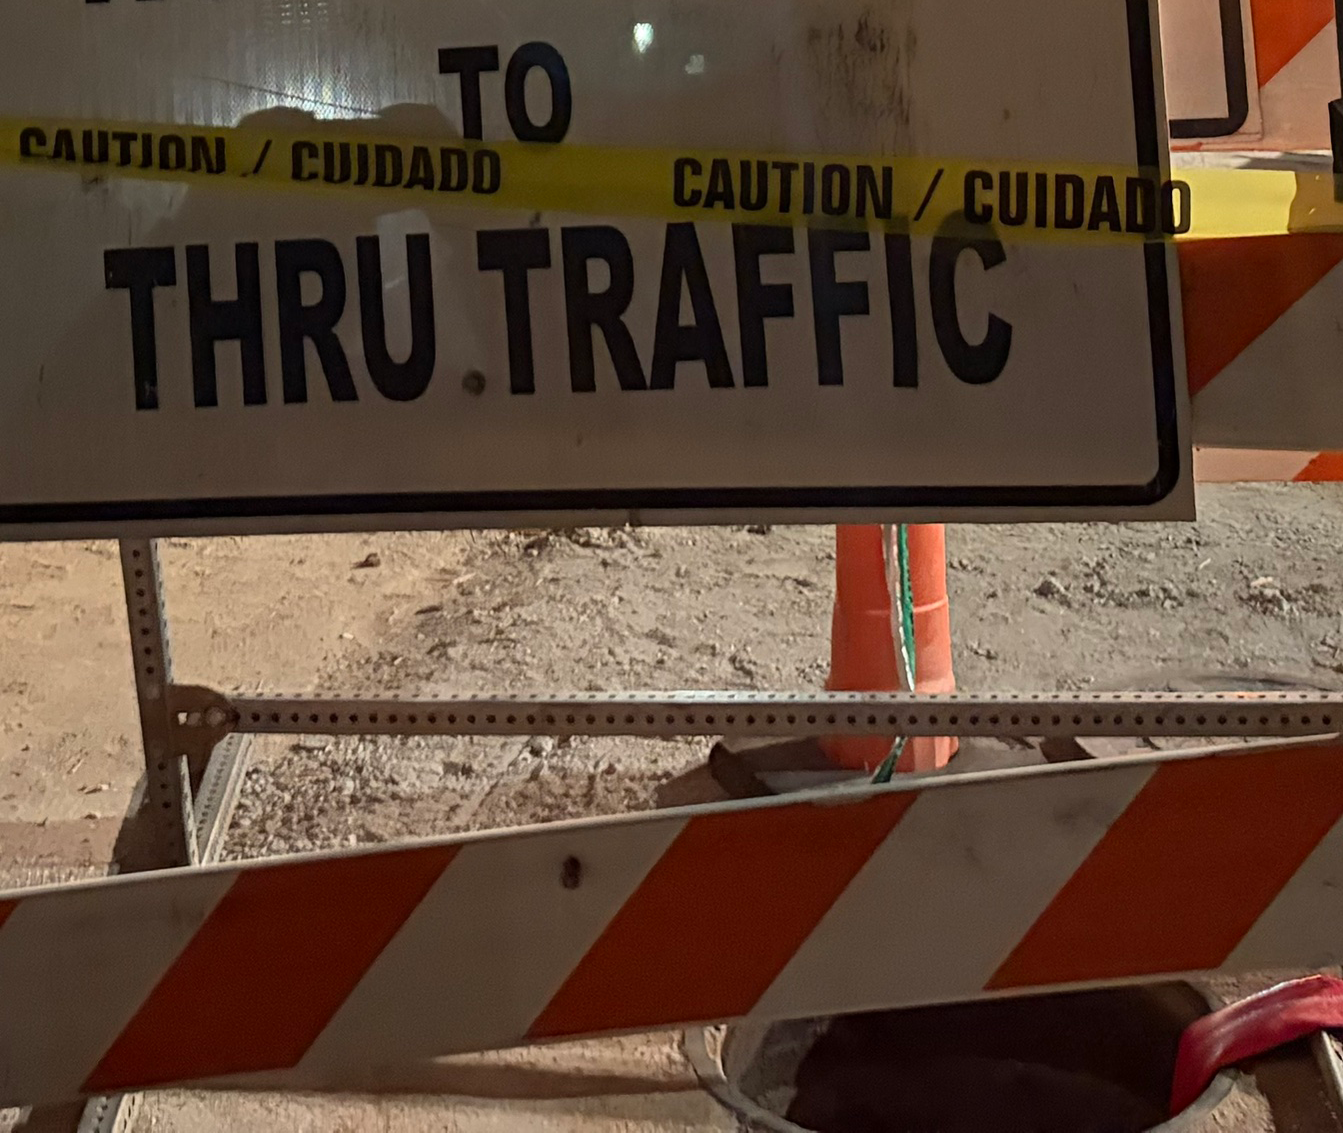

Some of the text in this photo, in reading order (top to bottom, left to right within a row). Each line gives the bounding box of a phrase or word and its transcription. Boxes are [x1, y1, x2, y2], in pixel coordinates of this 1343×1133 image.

[438, 41, 572, 143] TO
[19, 127, 226, 175] CAUTION
[291, 139, 502, 195] CUIDADO
[674, 157, 894, 219] CAUTION
[964, 170, 1192, 235] CUIDADO
[104, 212, 1013, 410] THRU TRAFFIC
